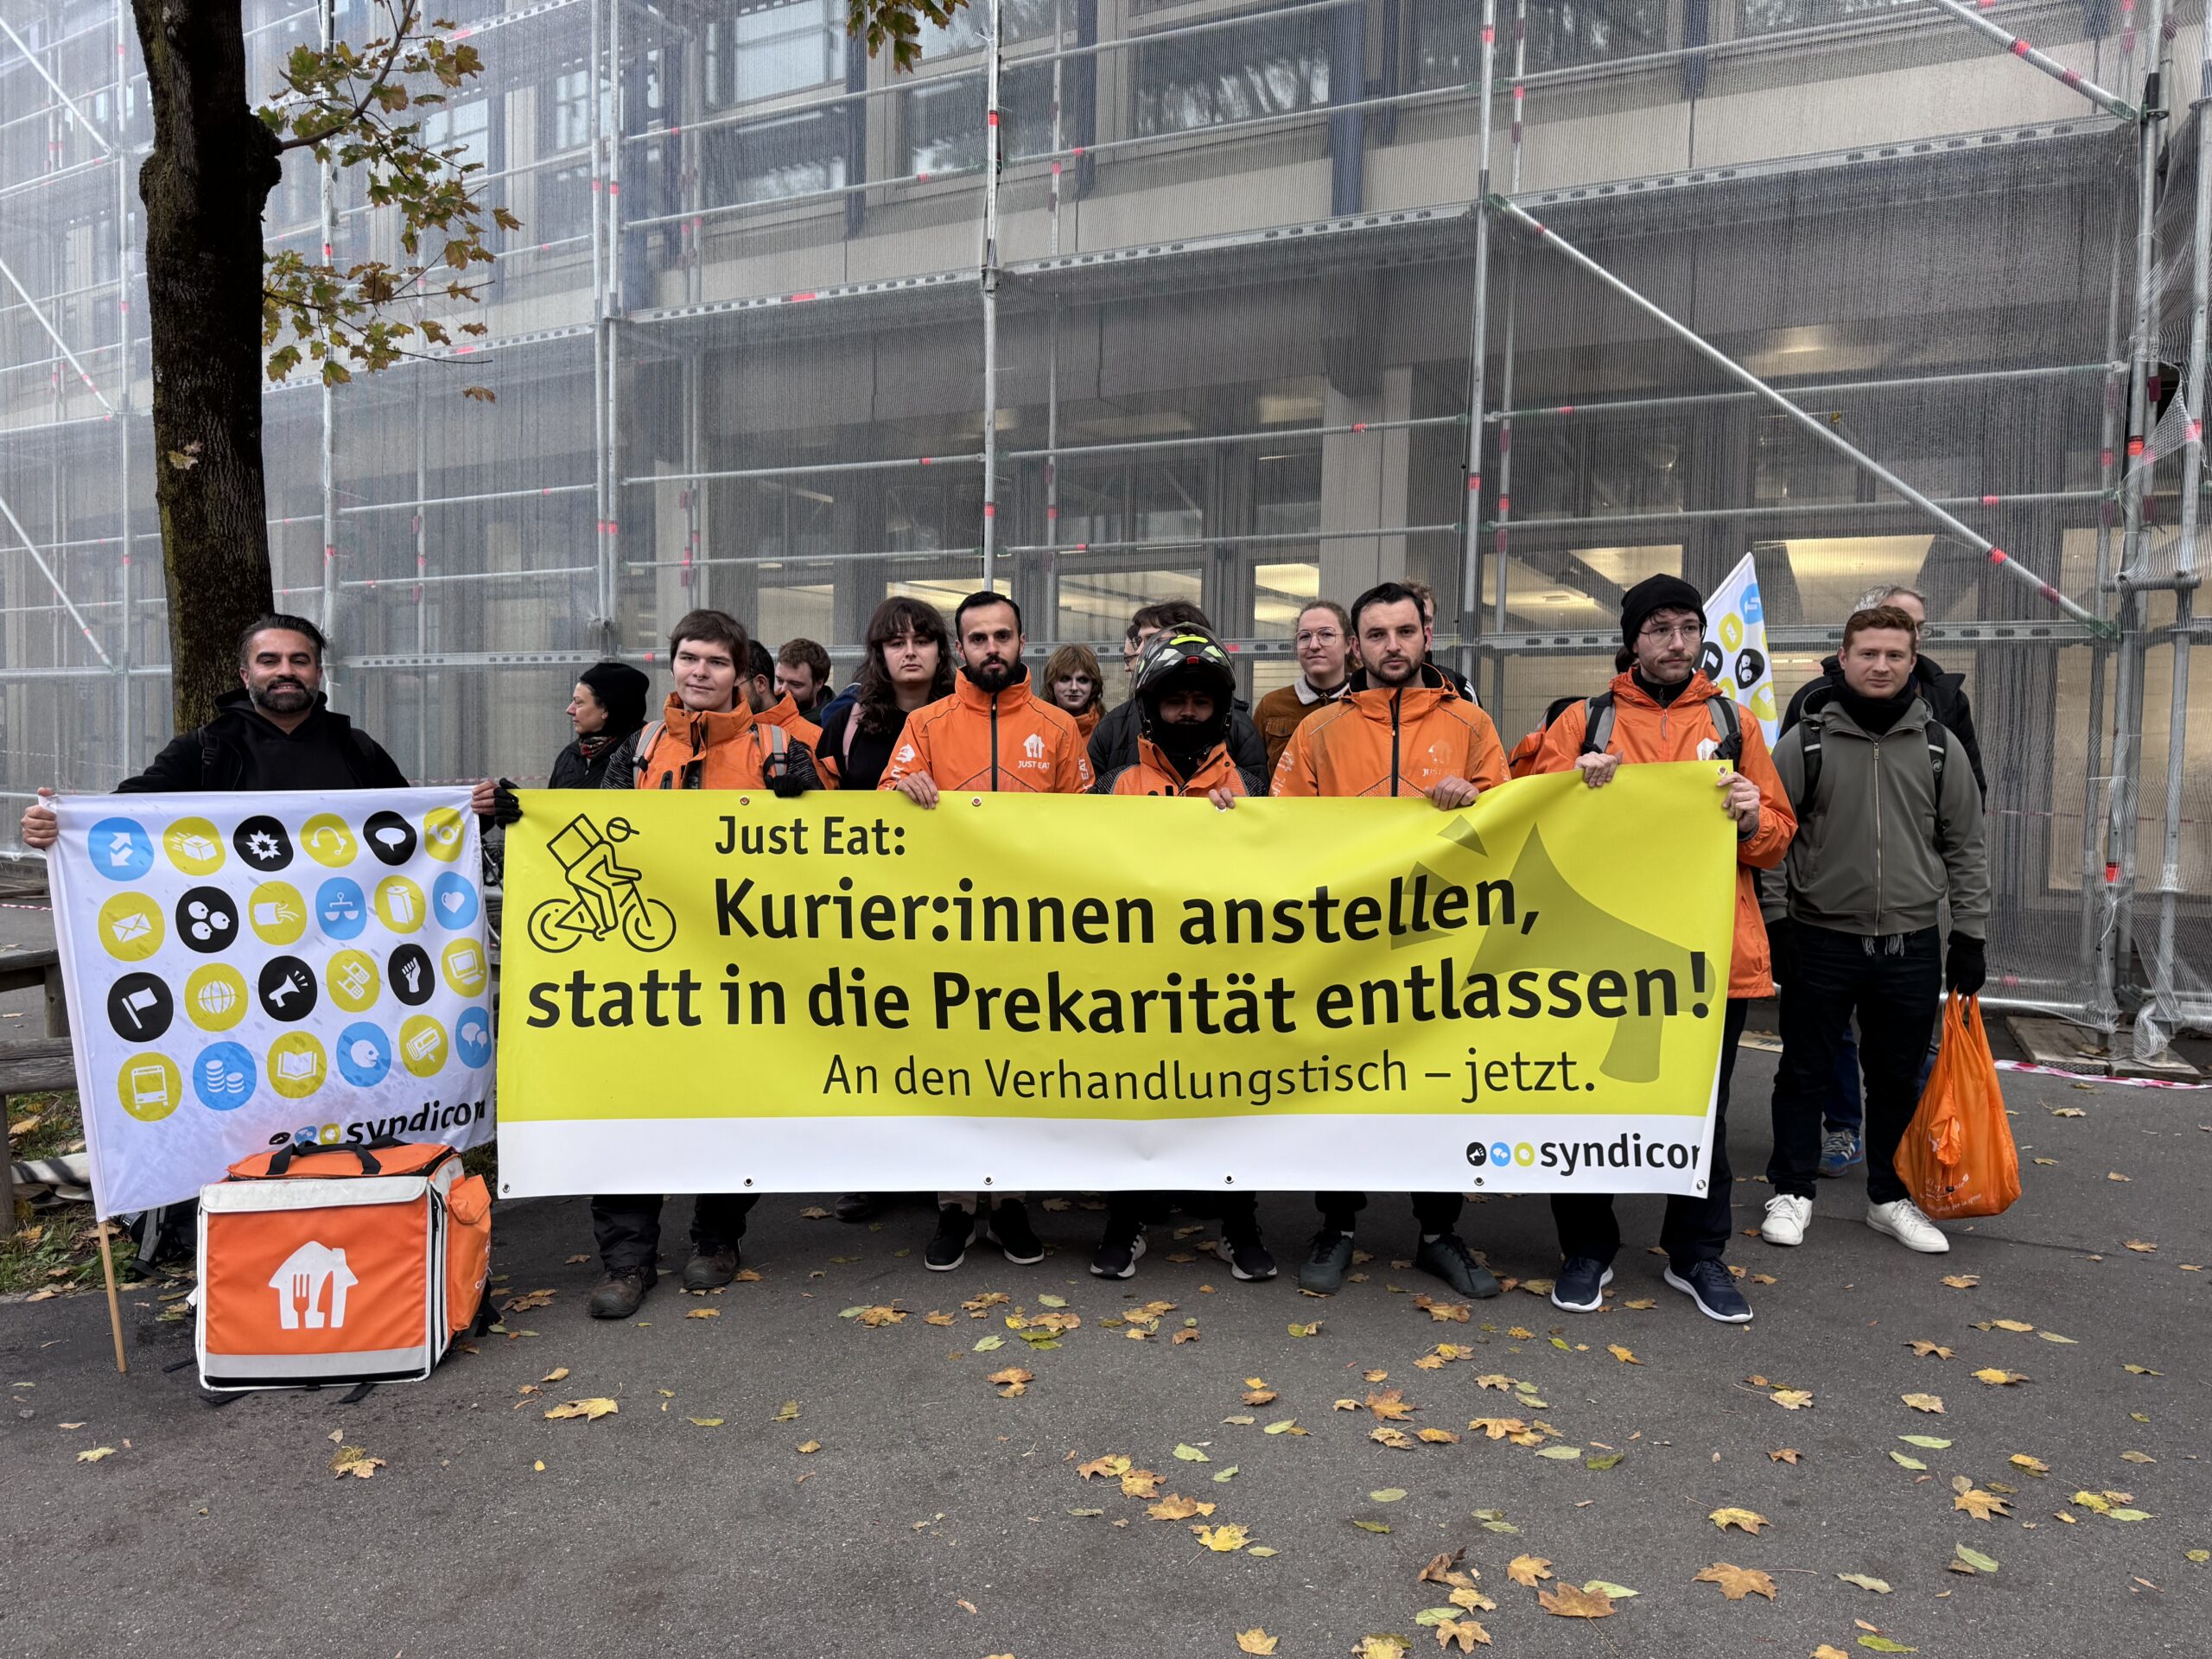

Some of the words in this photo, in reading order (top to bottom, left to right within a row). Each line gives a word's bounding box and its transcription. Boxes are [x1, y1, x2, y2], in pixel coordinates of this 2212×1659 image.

[1018, 760, 1037, 769] JUST
[1038, 762, 1051, 771] EAT
[715, 816, 809, 855] Just
[823, 817, 906, 855] Eat:
[715, 876, 1155, 944] Kurier:innen
[1179, 874, 1540, 945] anstellen,
[525, 969, 702, 1028] statt
[720, 963, 786, 1026] in
[808, 966, 910, 1029] die
[933, 970, 1296, 1035] Prekarität
[1316, 950, 1710, 1029] entlassen!
[823, 1054, 878, 1095] An
[894, 1055, 971, 1096] den
[984, 1049, 1408, 1106] Verhandlungstisch
[1461, 1047, 1596, 1104] jetzt.
